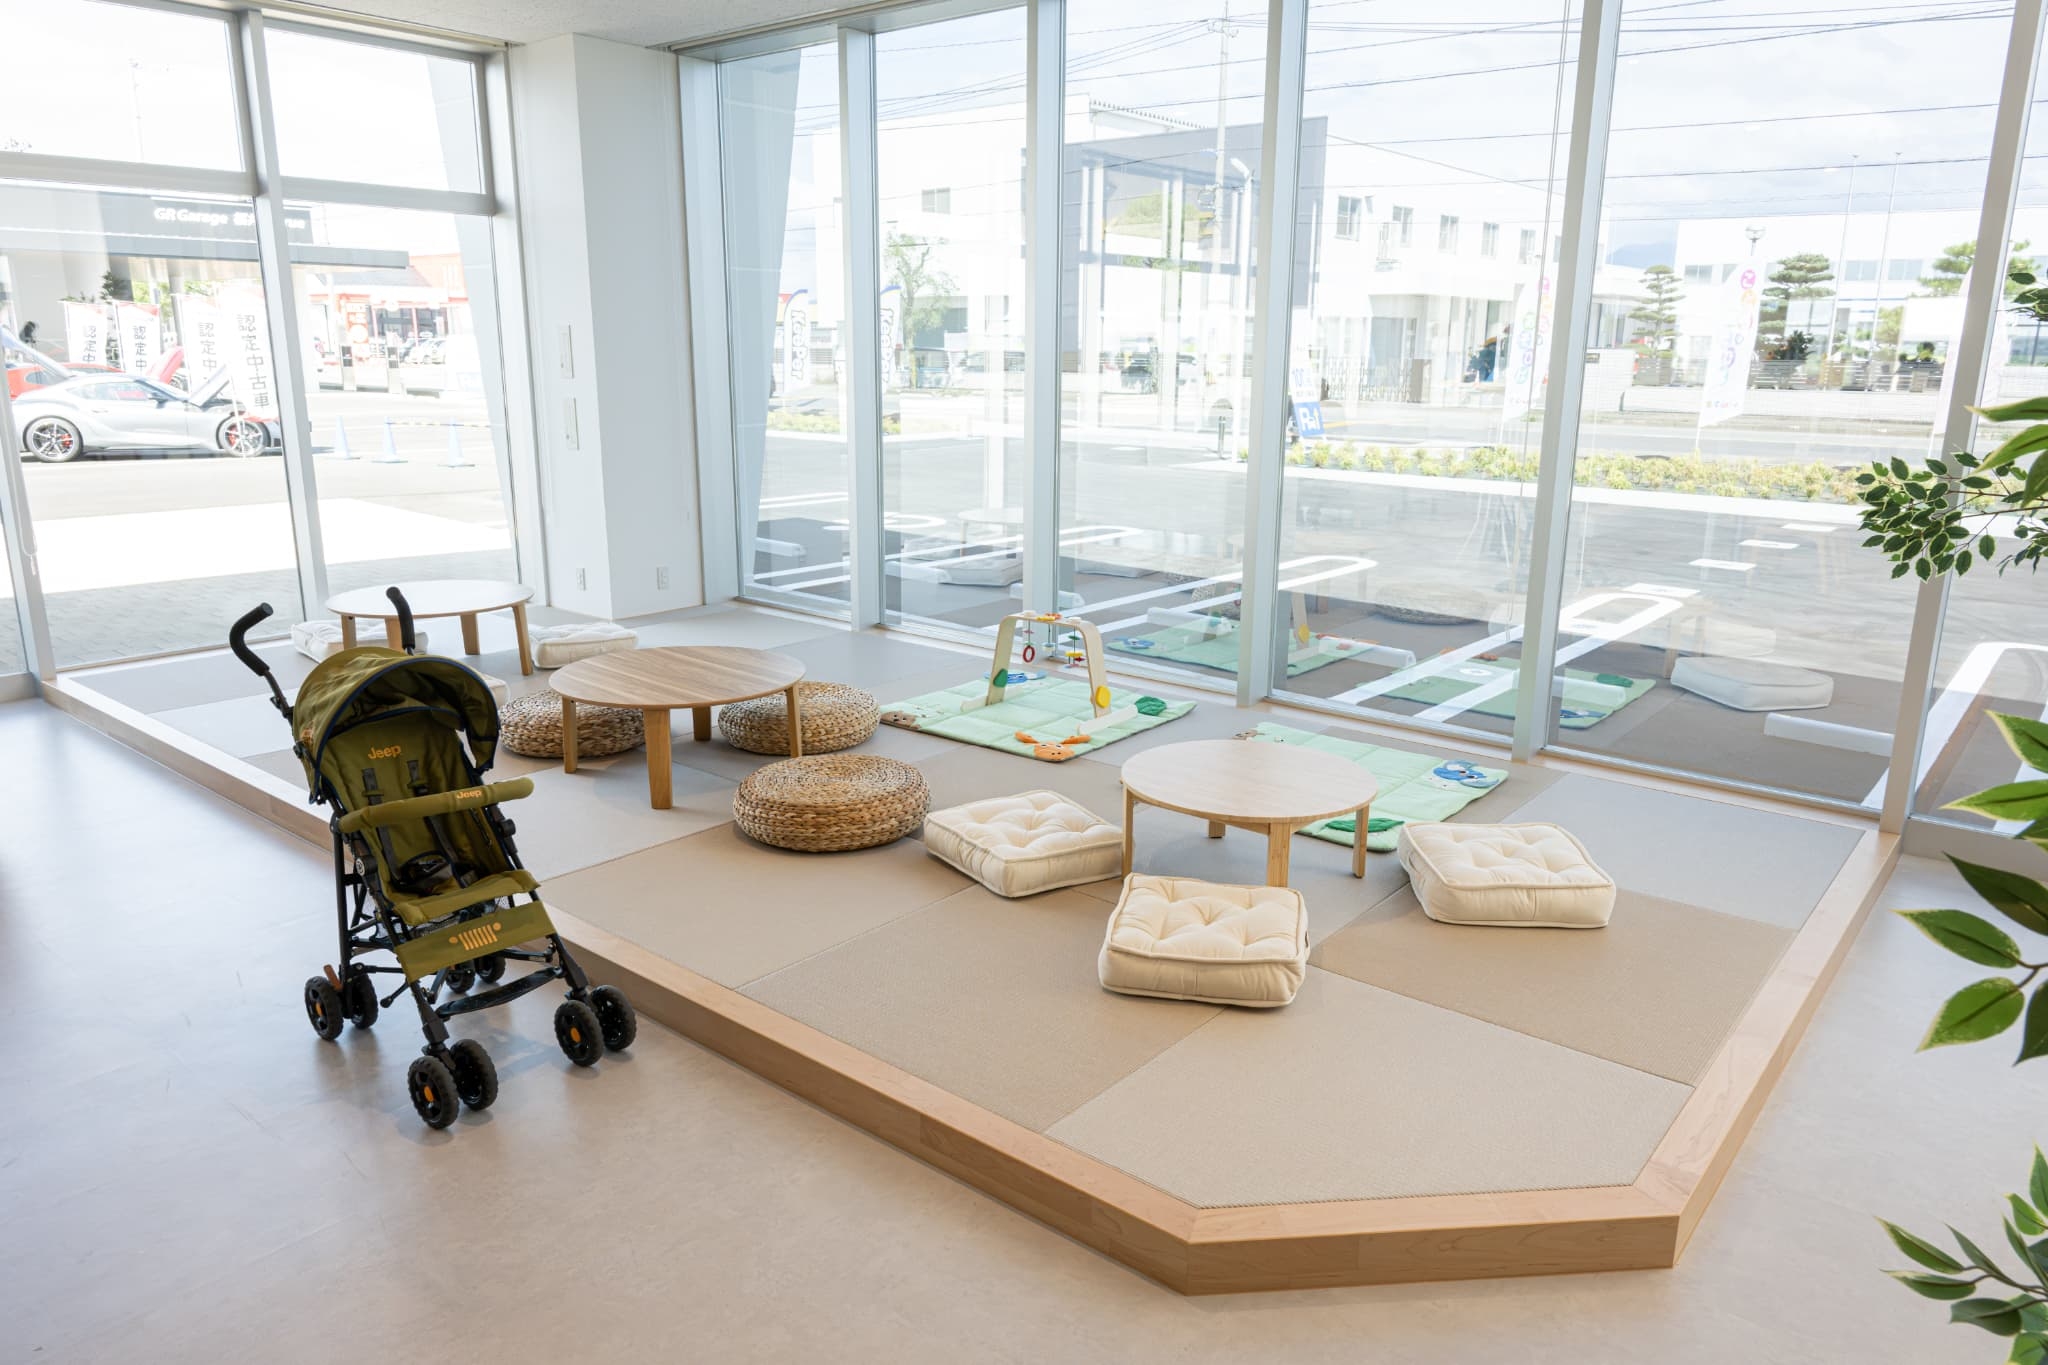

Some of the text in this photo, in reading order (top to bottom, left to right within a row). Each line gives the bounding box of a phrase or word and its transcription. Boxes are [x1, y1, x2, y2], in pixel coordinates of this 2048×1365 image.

[154, 207, 176, 221] GR
[177, 208, 228, 226] Garage
[199, 322, 217, 380] 認定中
[237, 313, 270, 408] 認定中古車
[368, 744, 402, 760] Jeep
[456, 789, 483, 800] Jeep
